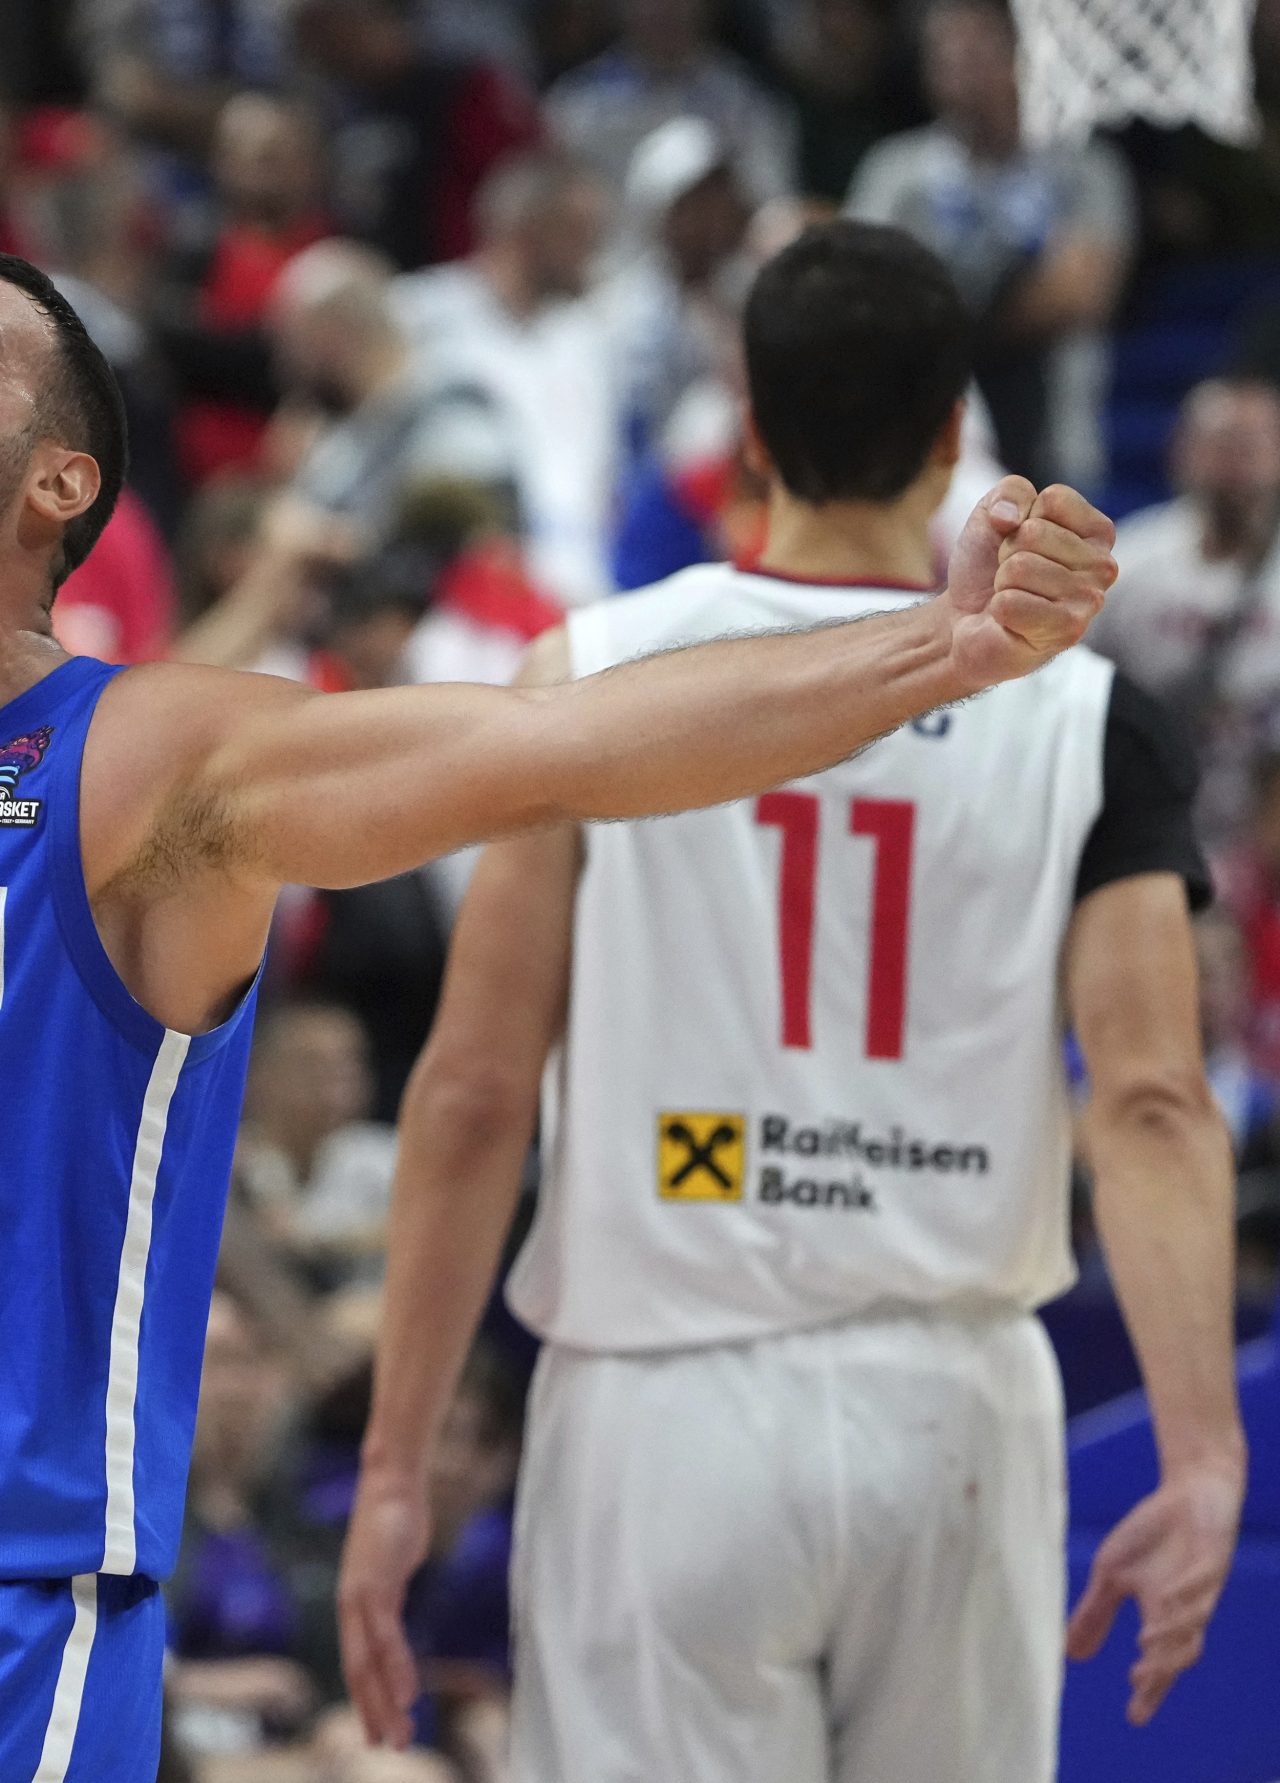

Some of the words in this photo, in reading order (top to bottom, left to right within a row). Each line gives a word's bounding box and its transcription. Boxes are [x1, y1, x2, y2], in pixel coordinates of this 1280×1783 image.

[754, 790, 916, 1060] 11
[760, 1114, 989, 1175] Raiffeisen
[759, 1166, 876, 1211] Bank
